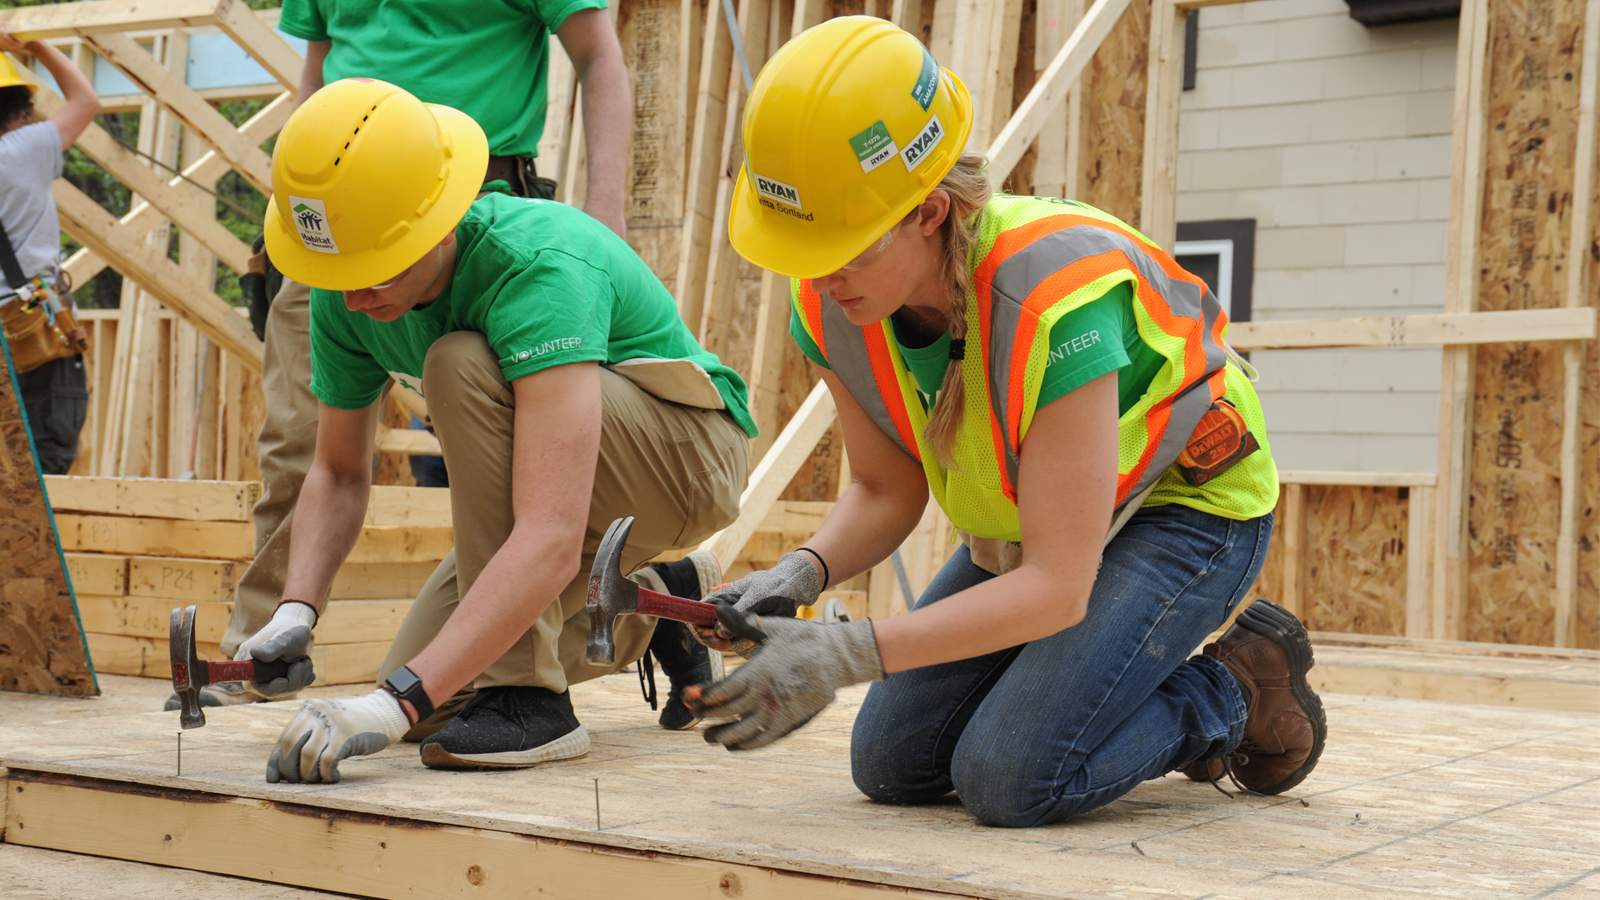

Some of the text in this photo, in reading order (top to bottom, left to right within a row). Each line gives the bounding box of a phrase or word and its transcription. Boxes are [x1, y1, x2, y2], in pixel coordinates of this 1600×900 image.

[923, 74, 936, 105] AMAZON
[858, 147, 874, 158] TARGET
[863, 134, 881, 148] T-1375
[905, 120, 941, 164] RYAN
[870, 150, 889, 165] RYAN
[758, 178, 798, 202] RYAN
[759, 198, 815, 222] ritta Sortland
[301, 233, 332, 245] Habitat
[511, 337, 582, 363] VOLUNTEER
[161, 566, 197, 591] P24
